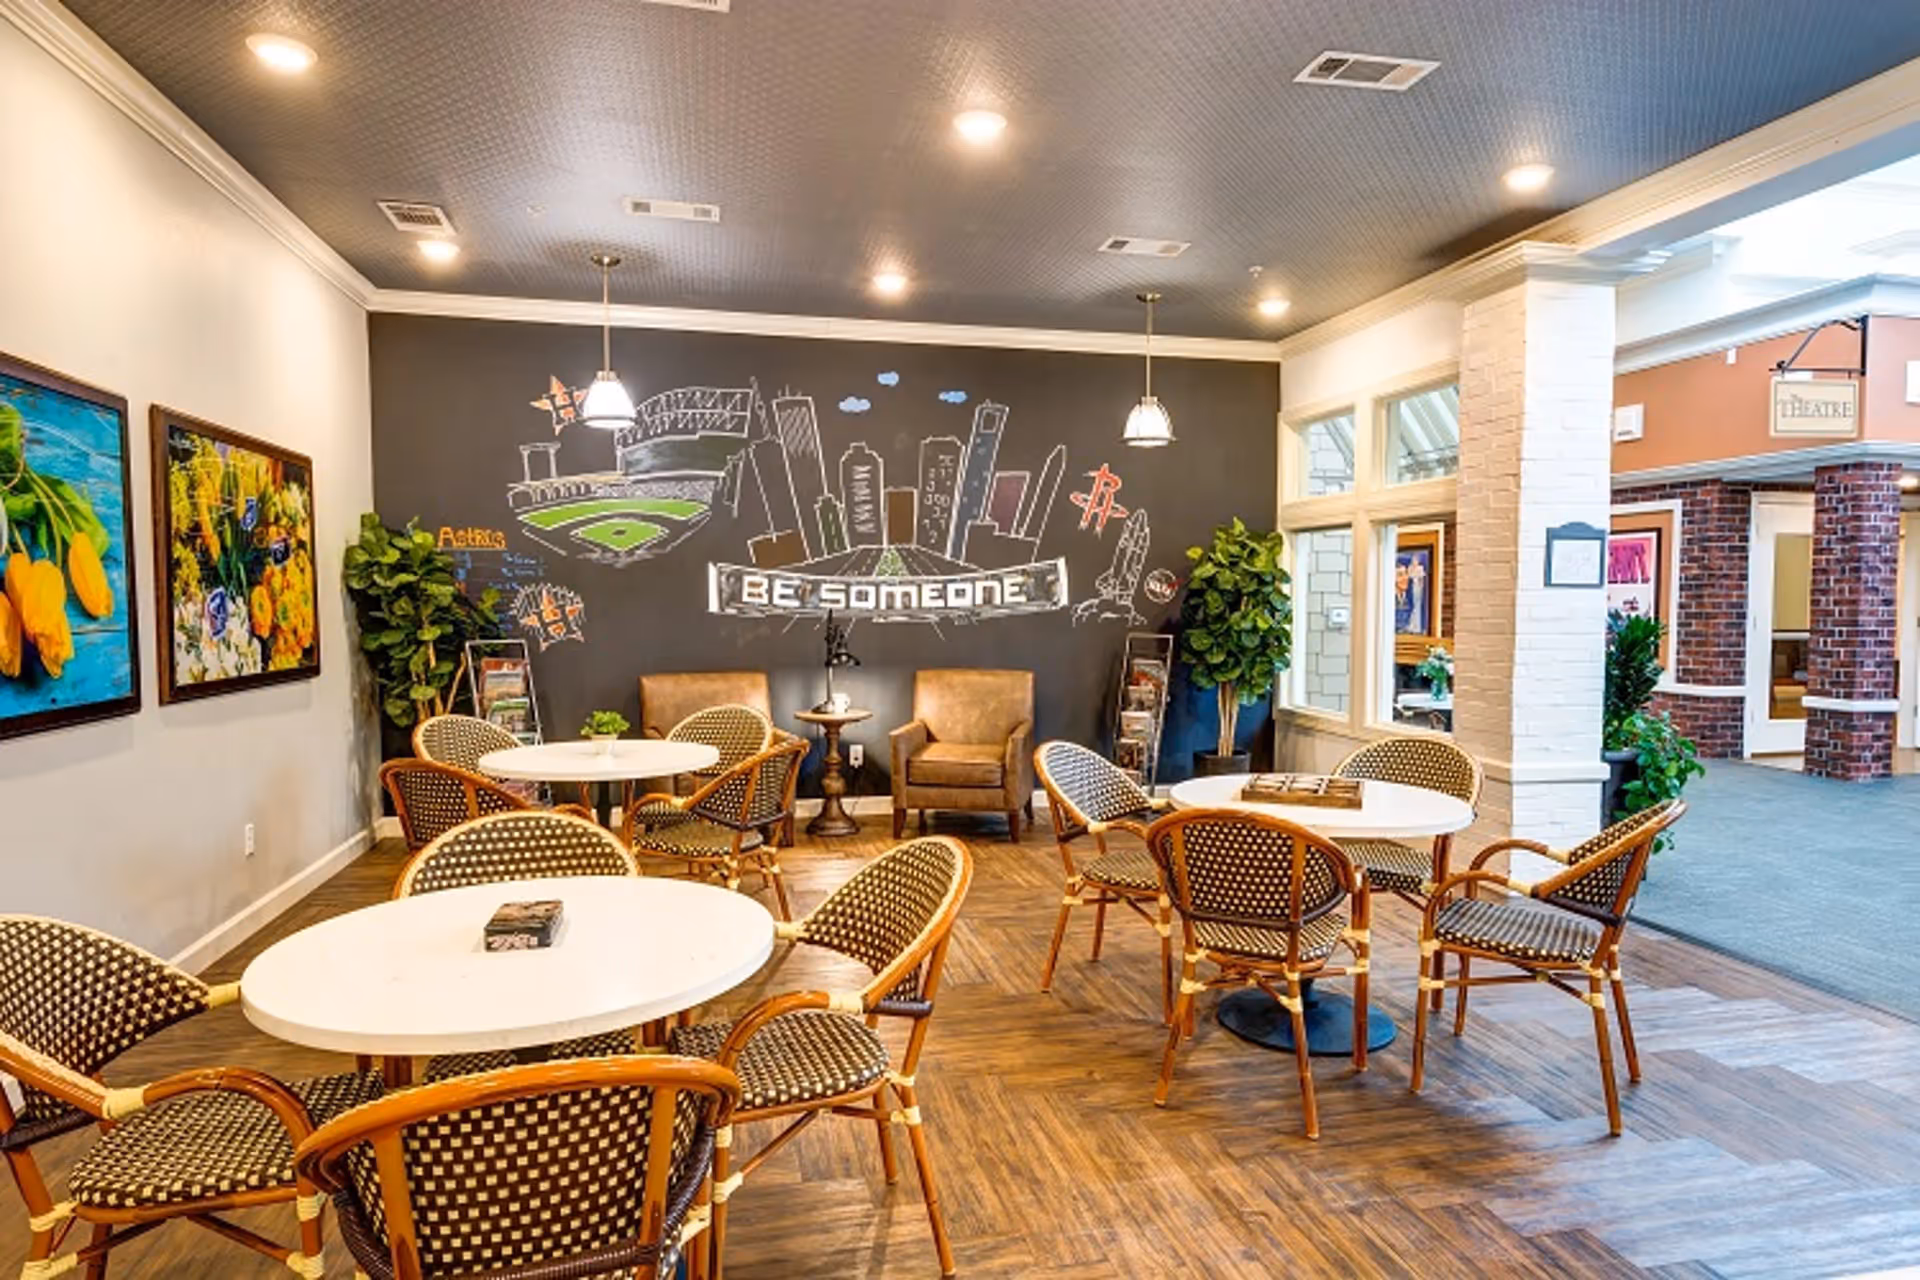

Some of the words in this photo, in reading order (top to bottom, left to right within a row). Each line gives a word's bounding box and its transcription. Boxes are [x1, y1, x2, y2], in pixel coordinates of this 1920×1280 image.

[1777, 399, 1853, 418] THEATRE
[742, 575, 801, 606] BE
[819, 576, 1027, 608] SOMEONE
